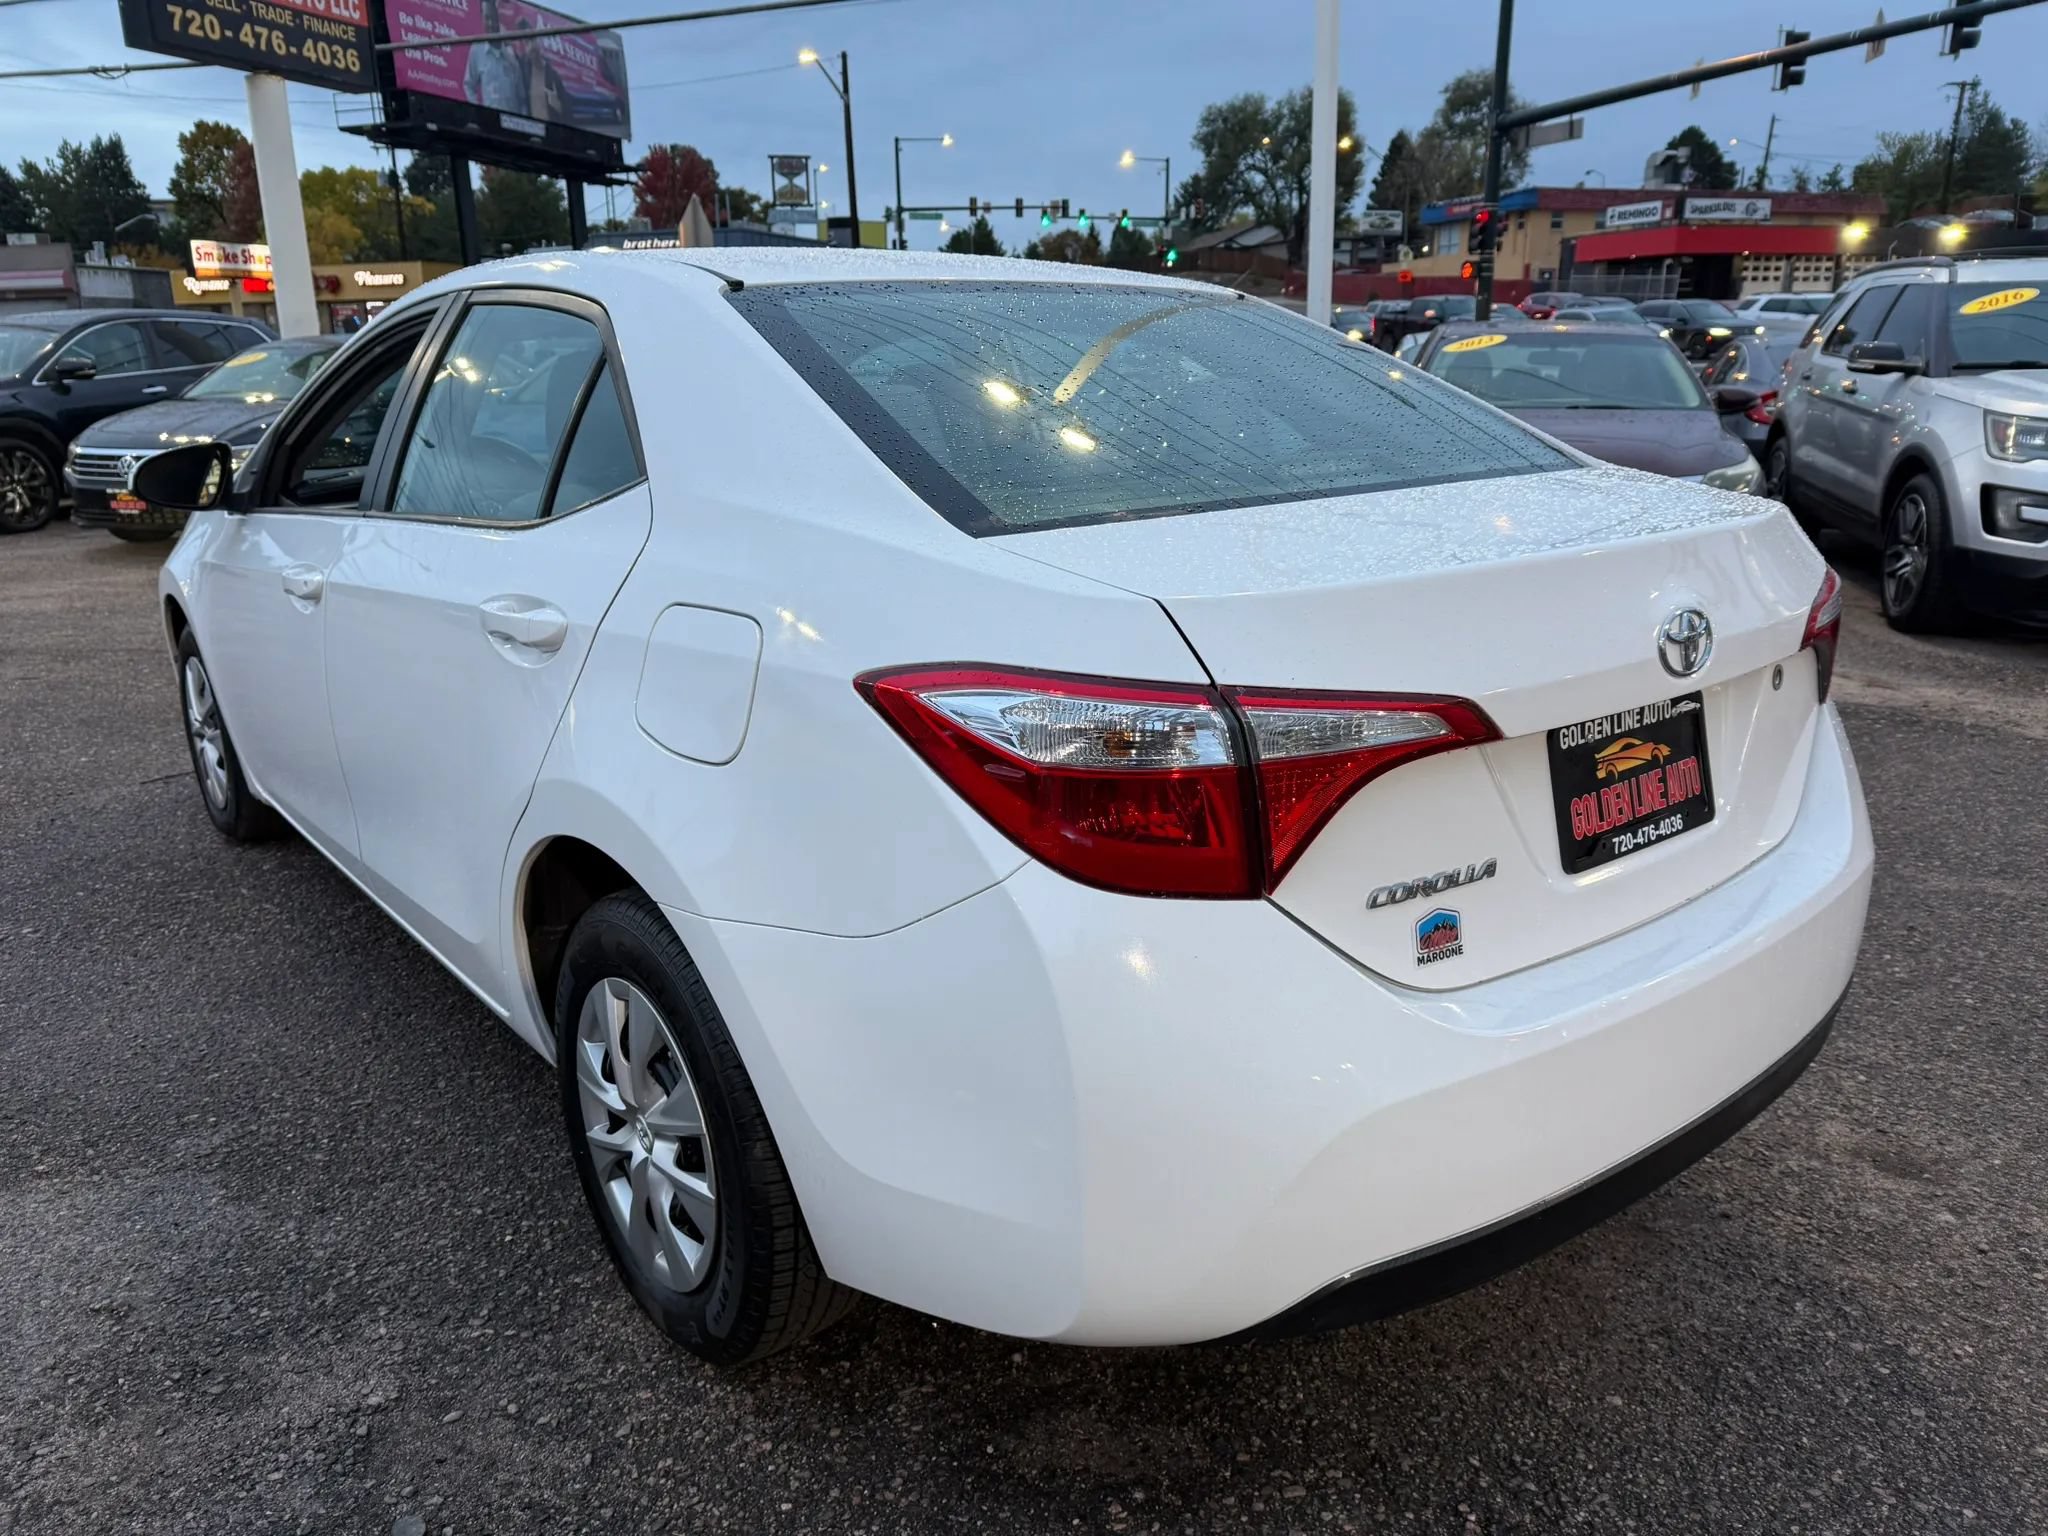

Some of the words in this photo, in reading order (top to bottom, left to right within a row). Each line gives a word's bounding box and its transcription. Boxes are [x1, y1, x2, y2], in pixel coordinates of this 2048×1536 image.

[251, 2, 295, 27] TRADE
[302, 14, 357, 42] FINANCE
[195, 245, 239, 265] Smoke
[1978, 290, 2026, 311] 2016
[1559, 718, 1612, 750] GOLDEN
[1613, 709, 1642, 734] LINE
[1642, 699, 1673, 726] AUTO
[1570, 779, 1634, 841] GOLDEN
[1631, 768, 1667, 817] LINE
[1666, 755, 1702, 806] AUTO
[1611, 813, 1684, 855] 720-476-4036
[1365, 857, 1498, 910] COROLLA
[1416, 944, 1465, 967] MAROONE
